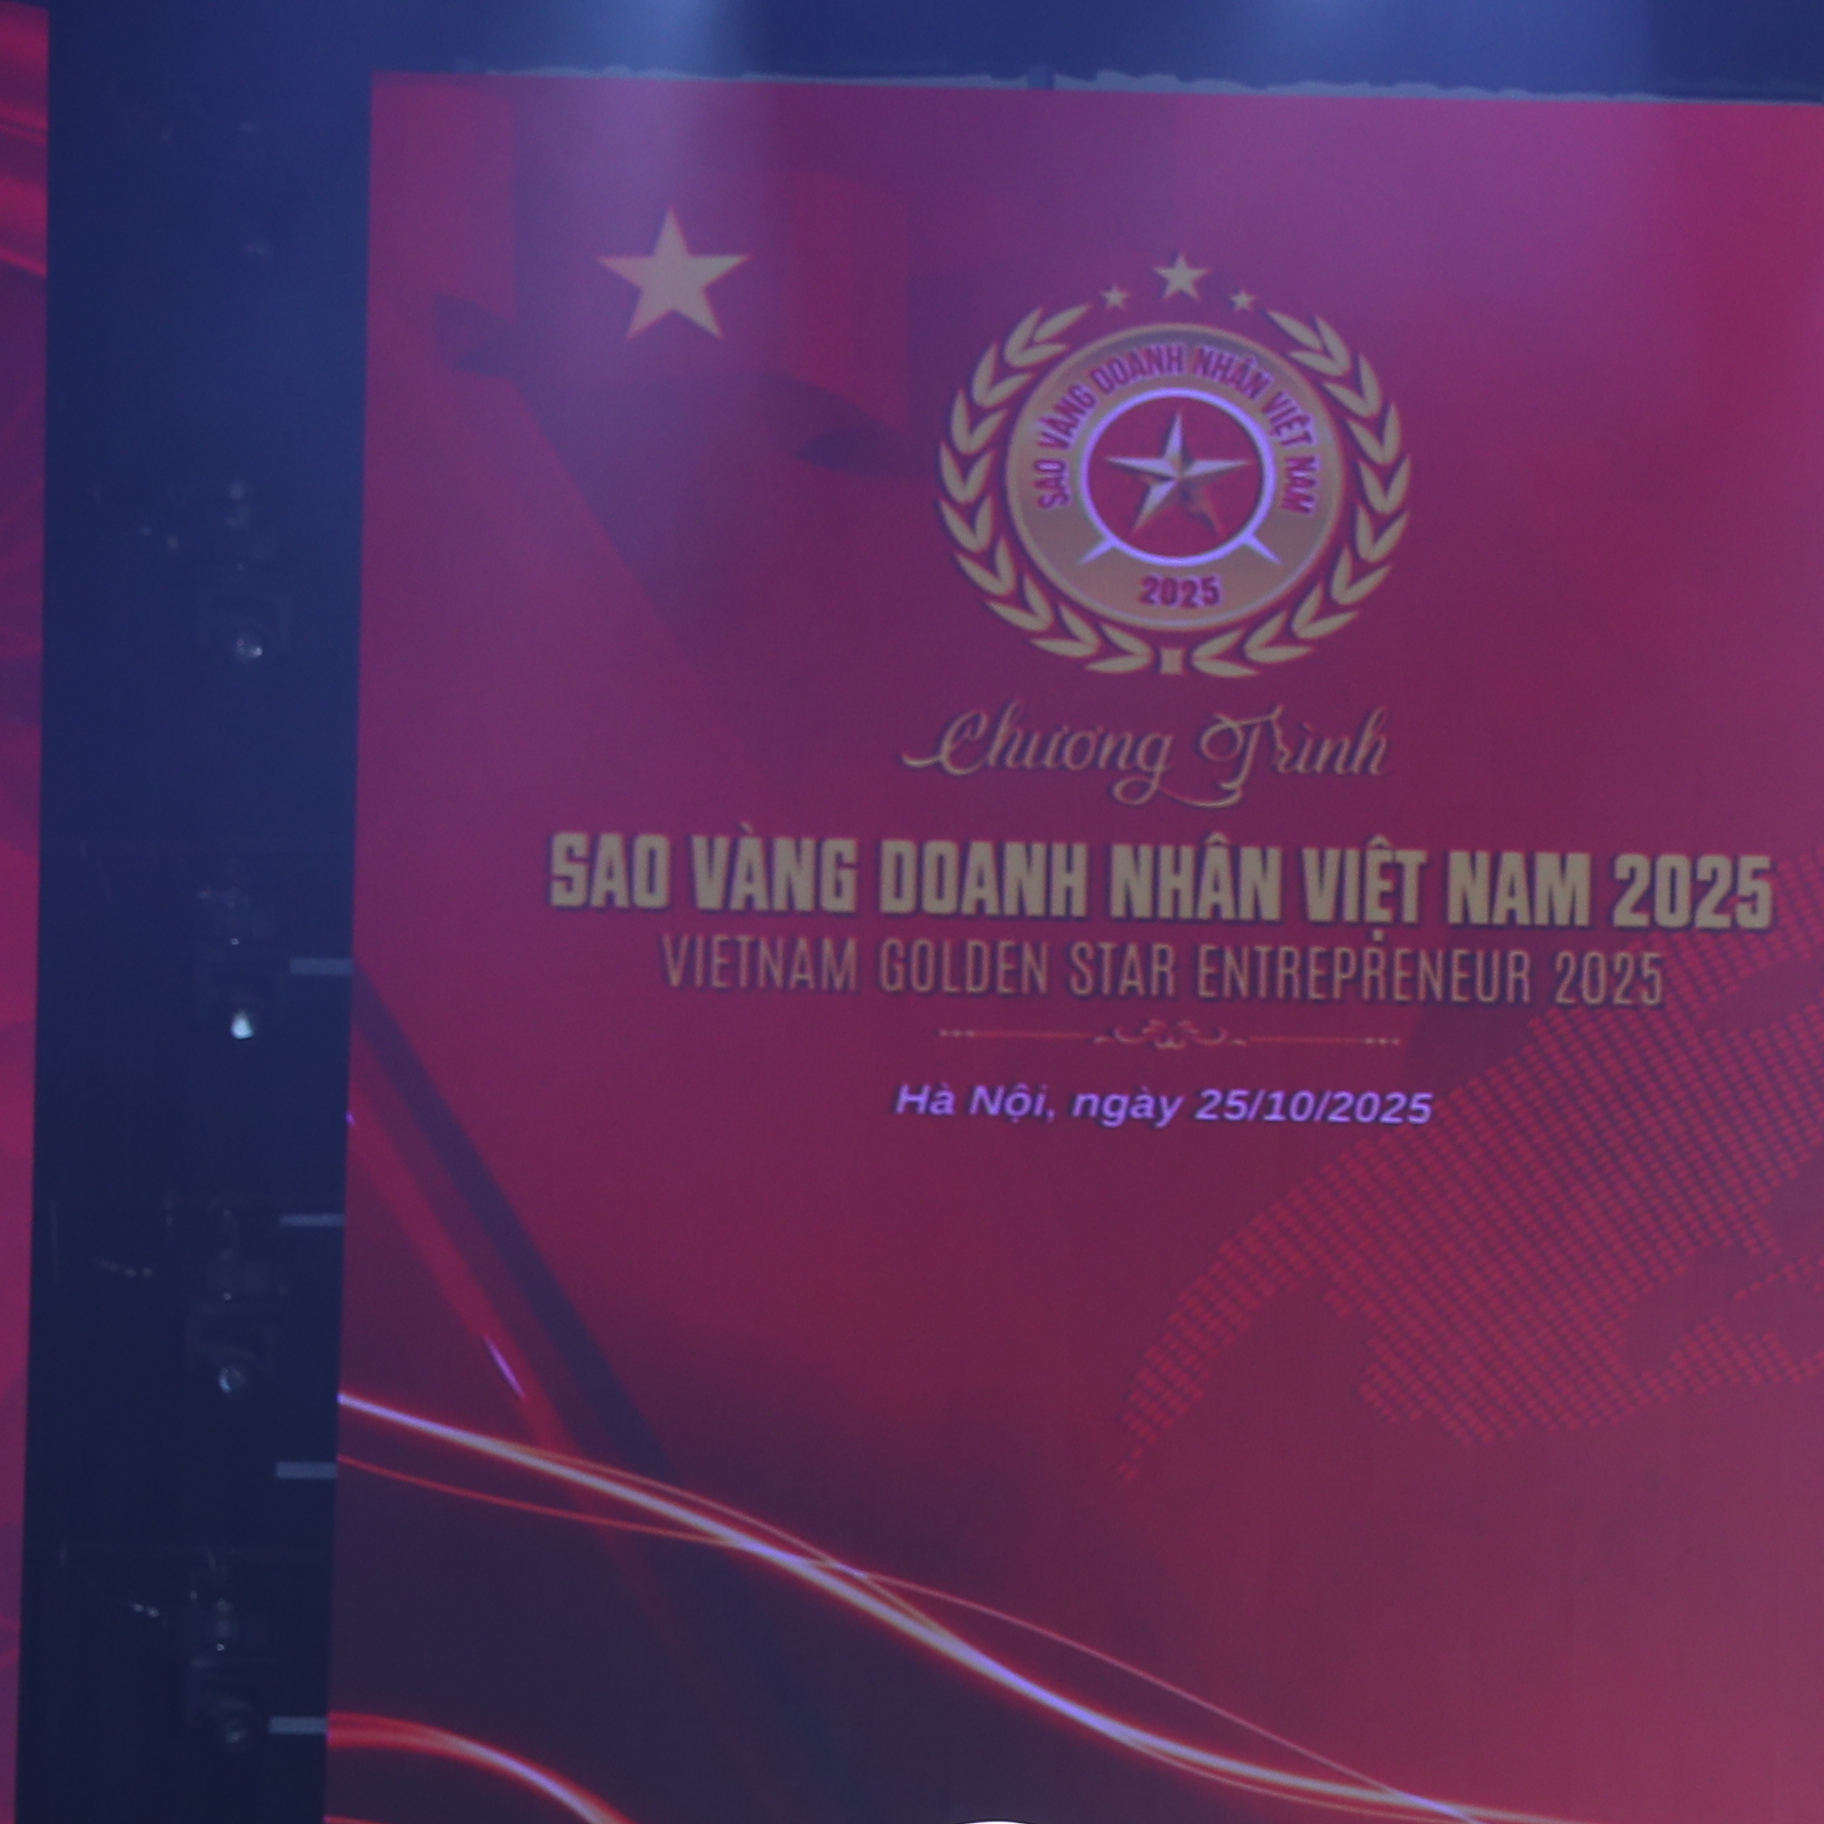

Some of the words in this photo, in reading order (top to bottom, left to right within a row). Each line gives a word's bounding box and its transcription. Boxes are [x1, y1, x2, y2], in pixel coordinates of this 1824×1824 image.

[1091, 344, 1186, 396] DOANH
[1194, 346, 1274, 399] NHÂN
[1037, 384, 1097, 450] VÀNG
[1261, 390, 1318, 448] VIỆT
[1034, 458, 1071, 509] SAO
[1282, 455, 1319, 515] NAM
[1140, 575, 1221, 608] 2025
[901, 702, 1175, 805] Chương
[1200, 704, 1392, 808] Trình
[550, 831, 671, 909] SAO
[691, 821, 858, 913] VÀNG
[878, 839, 1088, 919] DOANH
[1110, 832, 1282, 922] NHÂN
[1301, 834, 1427, 942] VIỆT
[1446, 849, 1592, 926] NAM
[1611, 852, 1773, 930] 2025
[661, 934, 858, 991] VIETNAM
[878, 937, 1048, 994] GOLDEN
[1070, 941, 1175, 997] STAR
[1198, 943, 1531, 1004] ENTREPRENEUR
[1554, 950, 1664, 1006] 2025
[896, 1082, 955, 1117] Hà
[969, 1083, 1055, 1124] Nội,
[1071, 1086, 1183, 1128] ngày
[1195, 1088, 1434, 1126] 25/10/2025
